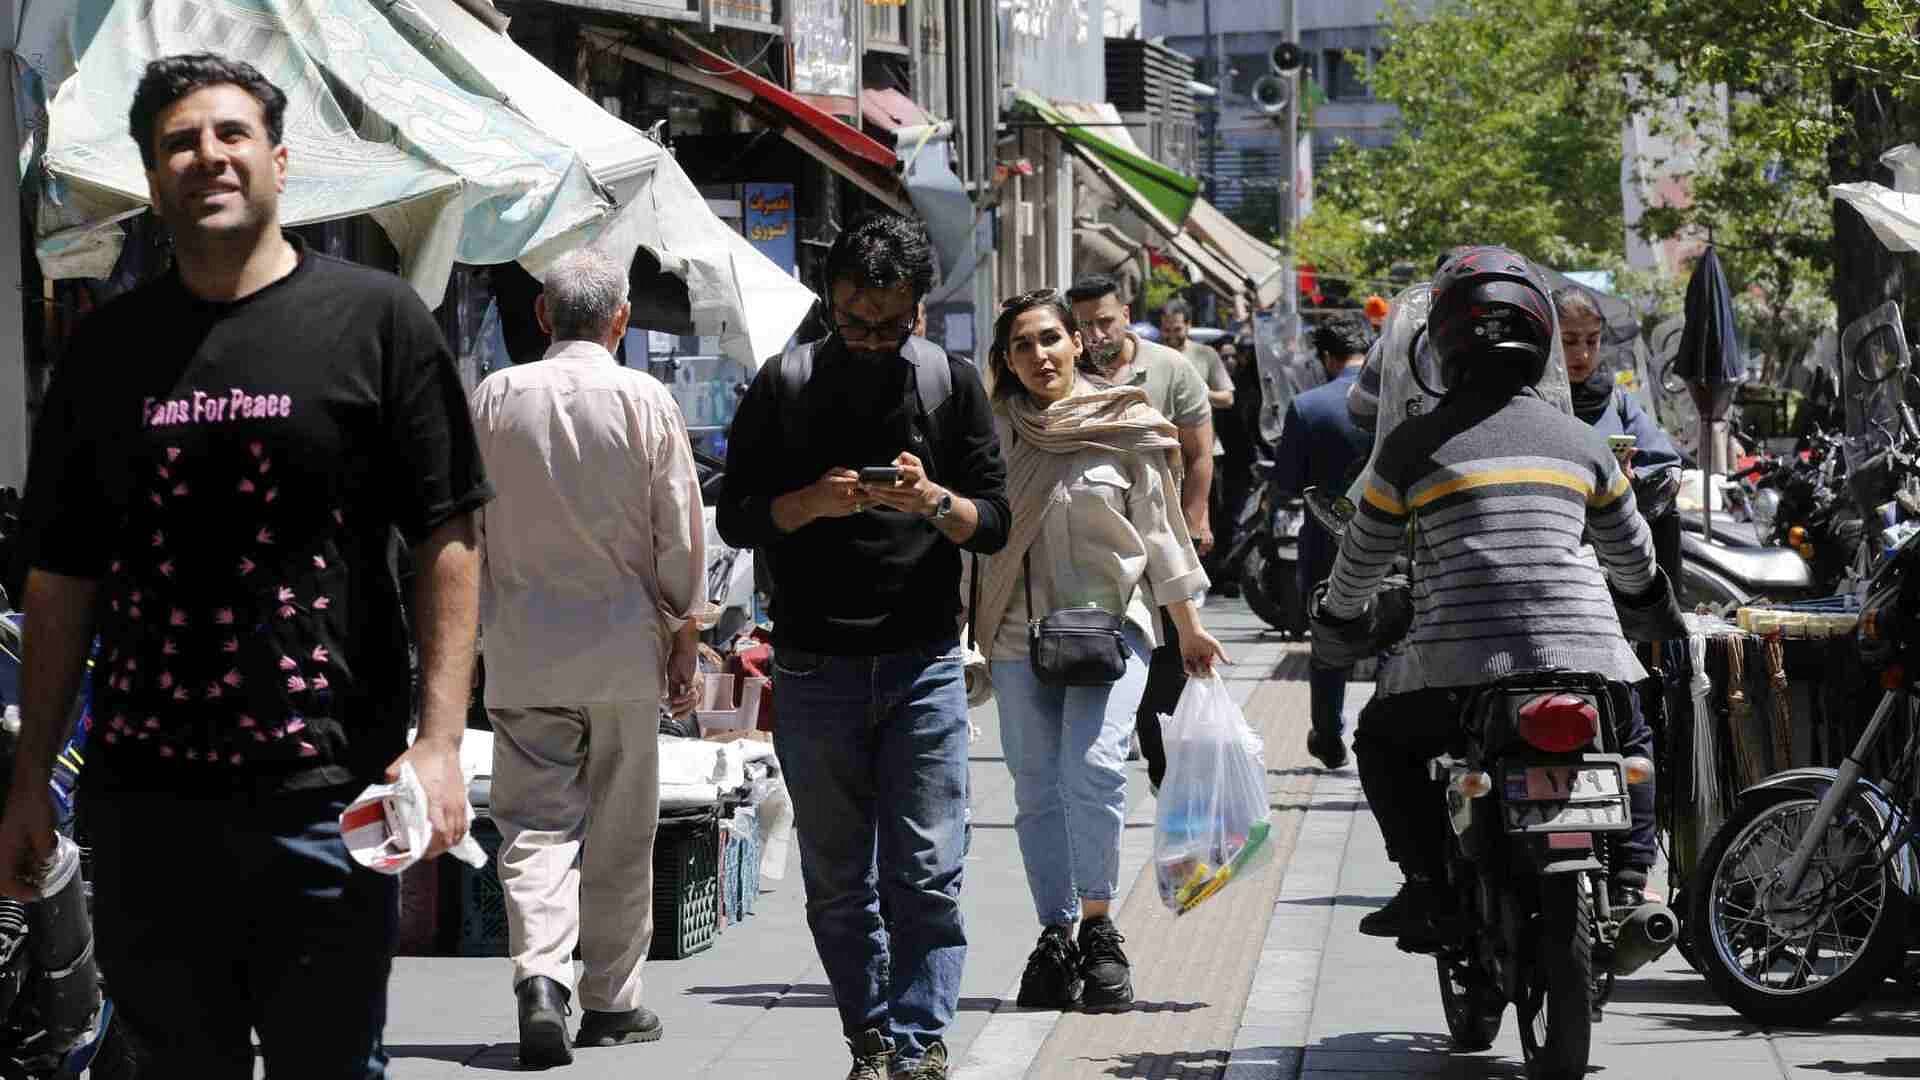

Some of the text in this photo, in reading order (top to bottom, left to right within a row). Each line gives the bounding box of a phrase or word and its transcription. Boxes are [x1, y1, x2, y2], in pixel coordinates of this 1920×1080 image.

[143, 388, 292, 426] Fans For Peace
